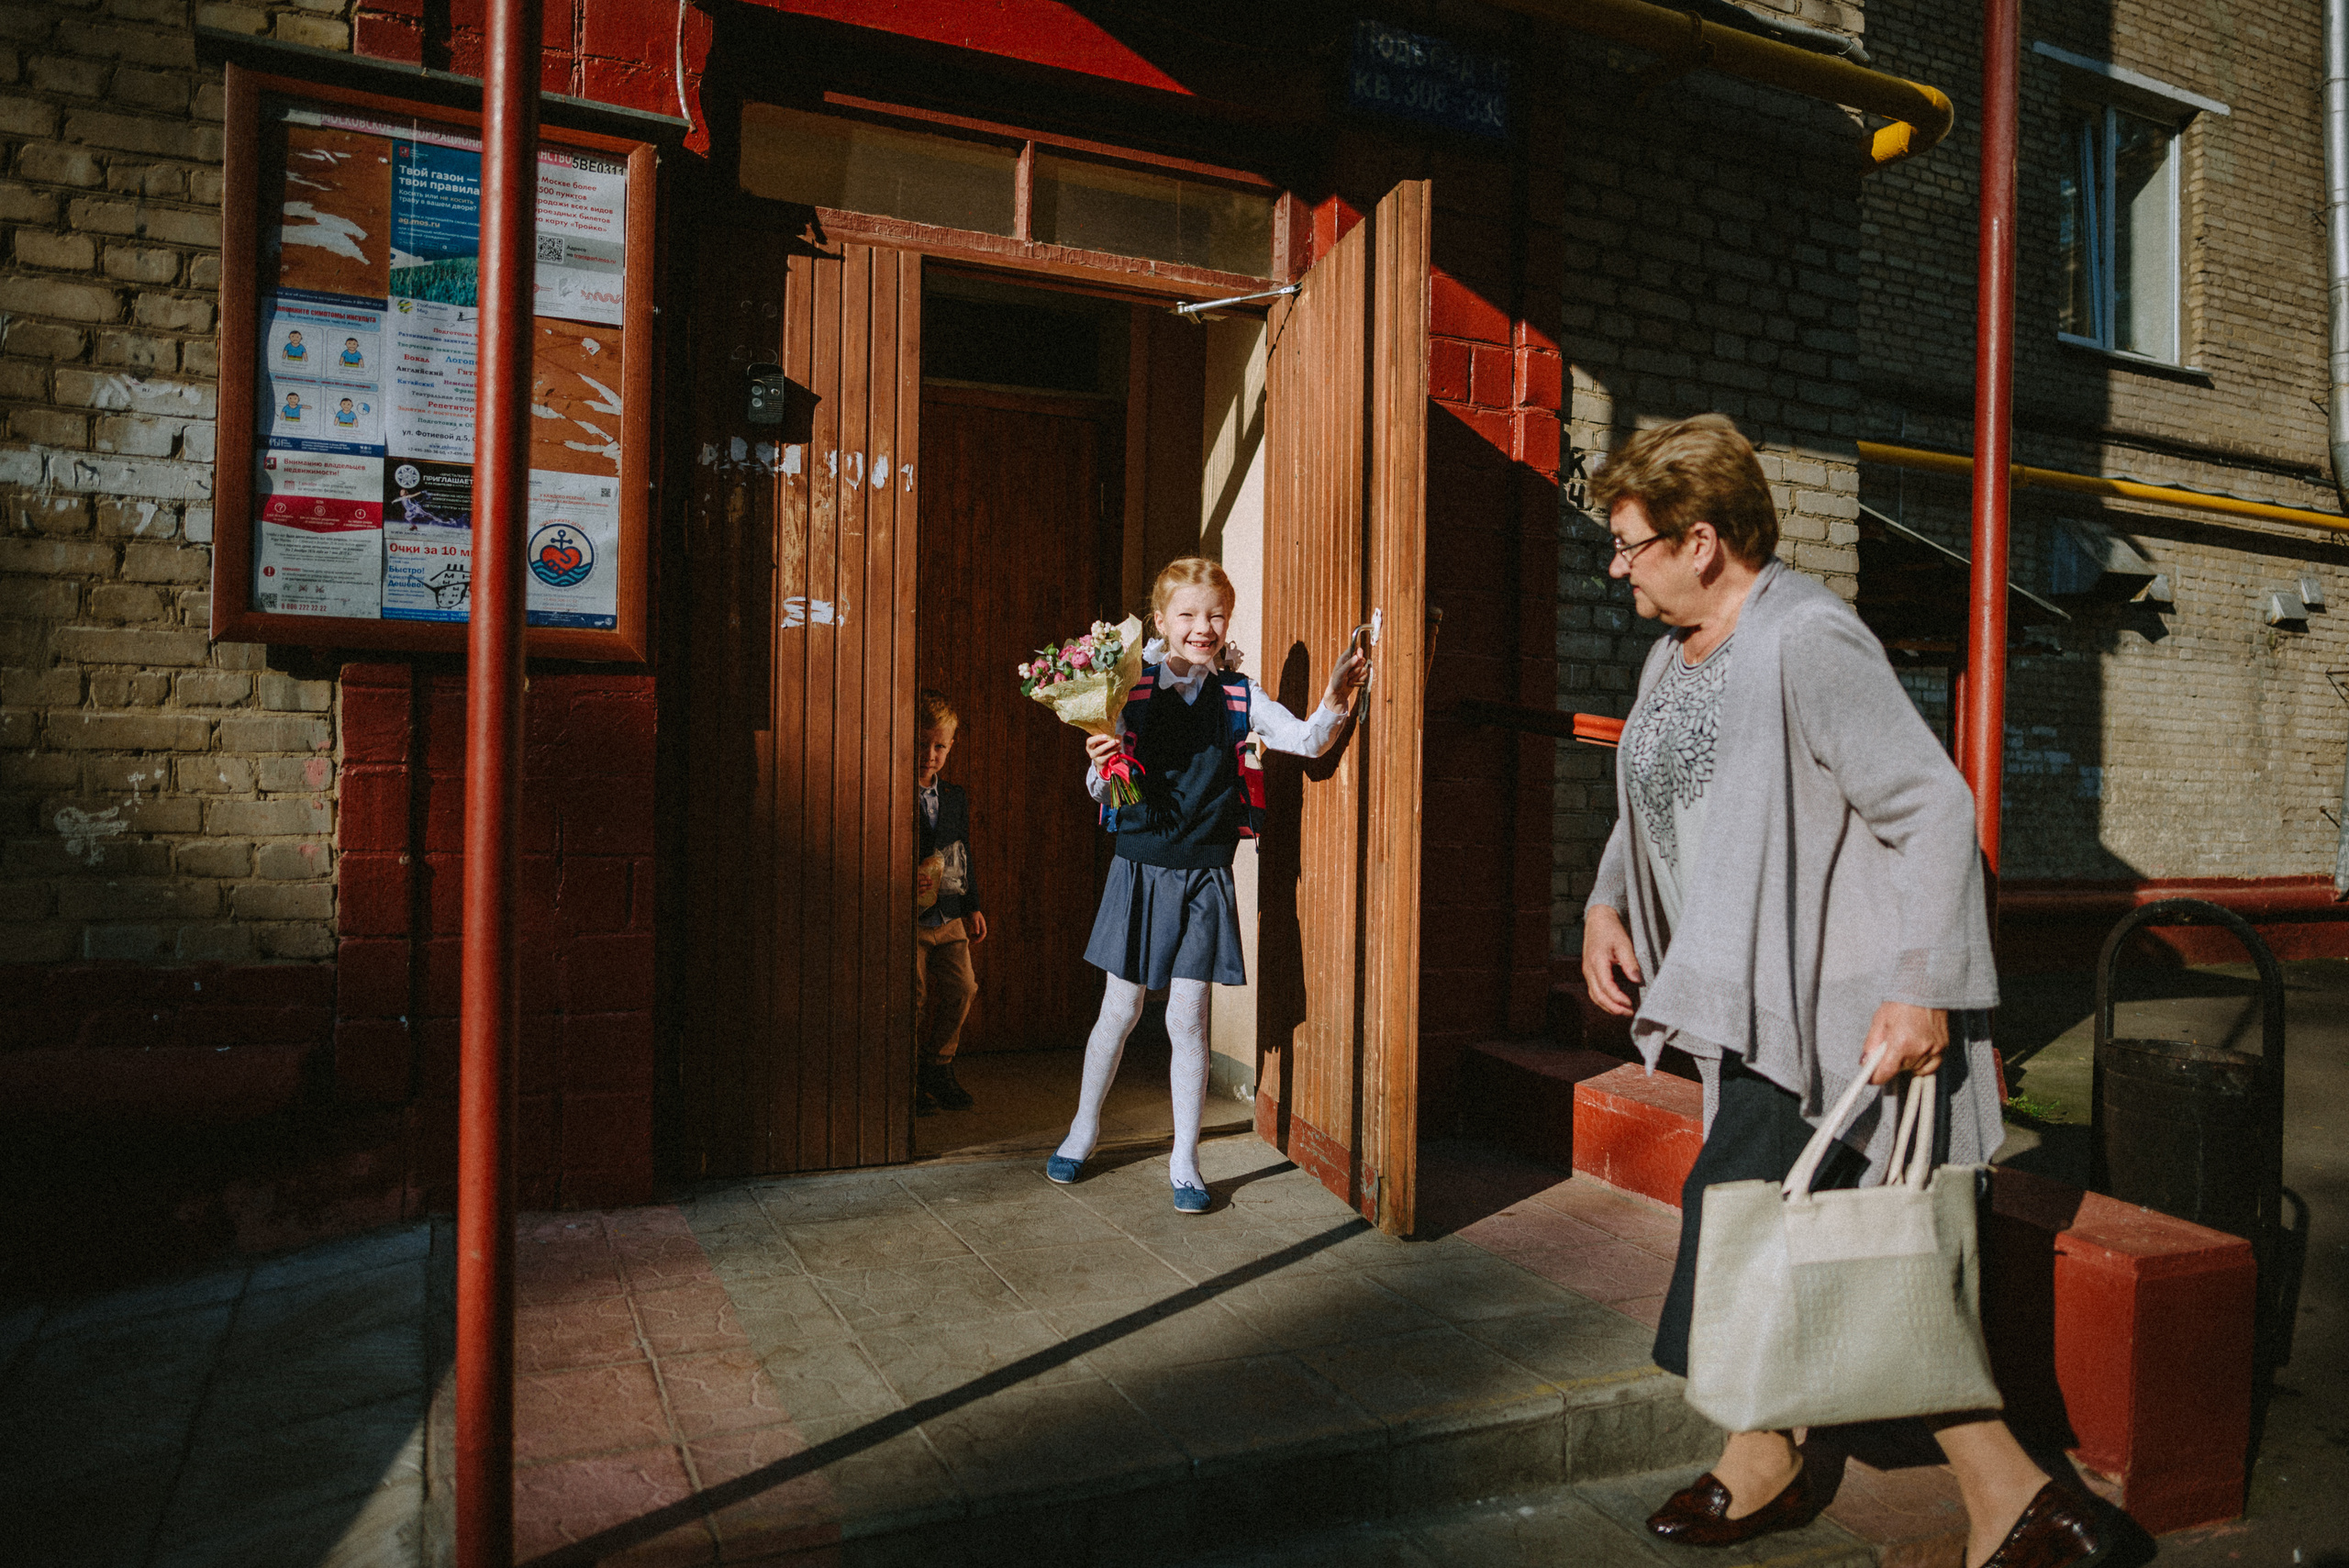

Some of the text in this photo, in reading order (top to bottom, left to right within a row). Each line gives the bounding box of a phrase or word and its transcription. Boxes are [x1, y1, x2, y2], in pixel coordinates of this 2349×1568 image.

[322, 112, 483, 149] МОСКОВСКОЕ ИНФОРМАЦИОНН
[537, 150, 572, 164] НСТВО
[398, 164, 428, 177] Твой
[431, 172, 463, 183] газон
[399, 177, 428, 187] твои
[541, 176, 596, 191] Москве более
[398, 189, 423, 197] Косить
[451, 196, 473, 205] косить
[537, 185, 587, 200] 500 пунктов
[399, 196, 419, 205] траву
[427, 200, 451, 208] вашем
[536, 197, 569, 207] родажи
[590, 206, 613, 215] видов
[535, 208, 611, 224] роездных билетов
[398, 217, 440, 228] ag.mos.ru
[546, 218, 568, 227] карту
[571, 221, 607, 232] «Тройка»
[574, 253, 617, 264] transport.mos.ru
[417, 303, 448, 311] Глобальный
[347, 314, 376, 323] инсульта
[398, 331, 442, 341] Развивающие
[433, 328, 472, 338] Подготовка
[397, 341, 434, 350] Творческие
[404, 354, 429, 363] Вокал
[396, 365, 444, 376] Английский
[397, 379, 435, 388] Китайский
[411, 391, 453, 400] Театральная
[428, 401, 474, 413] Репетитор
[433, 410, 469, 418] носителем
[417, 417, 457, 427] Подготовка
[416, 429, 453, 439] Фотиевой
[284, 458, 366, 471] Вниманию владельцев
[284, 468, 340, 476] недвижимости!
[389, 542, 420, 553] Очки
[441, 546, 457, 556] 10
[388, 565, 425, 574] Быстро!
